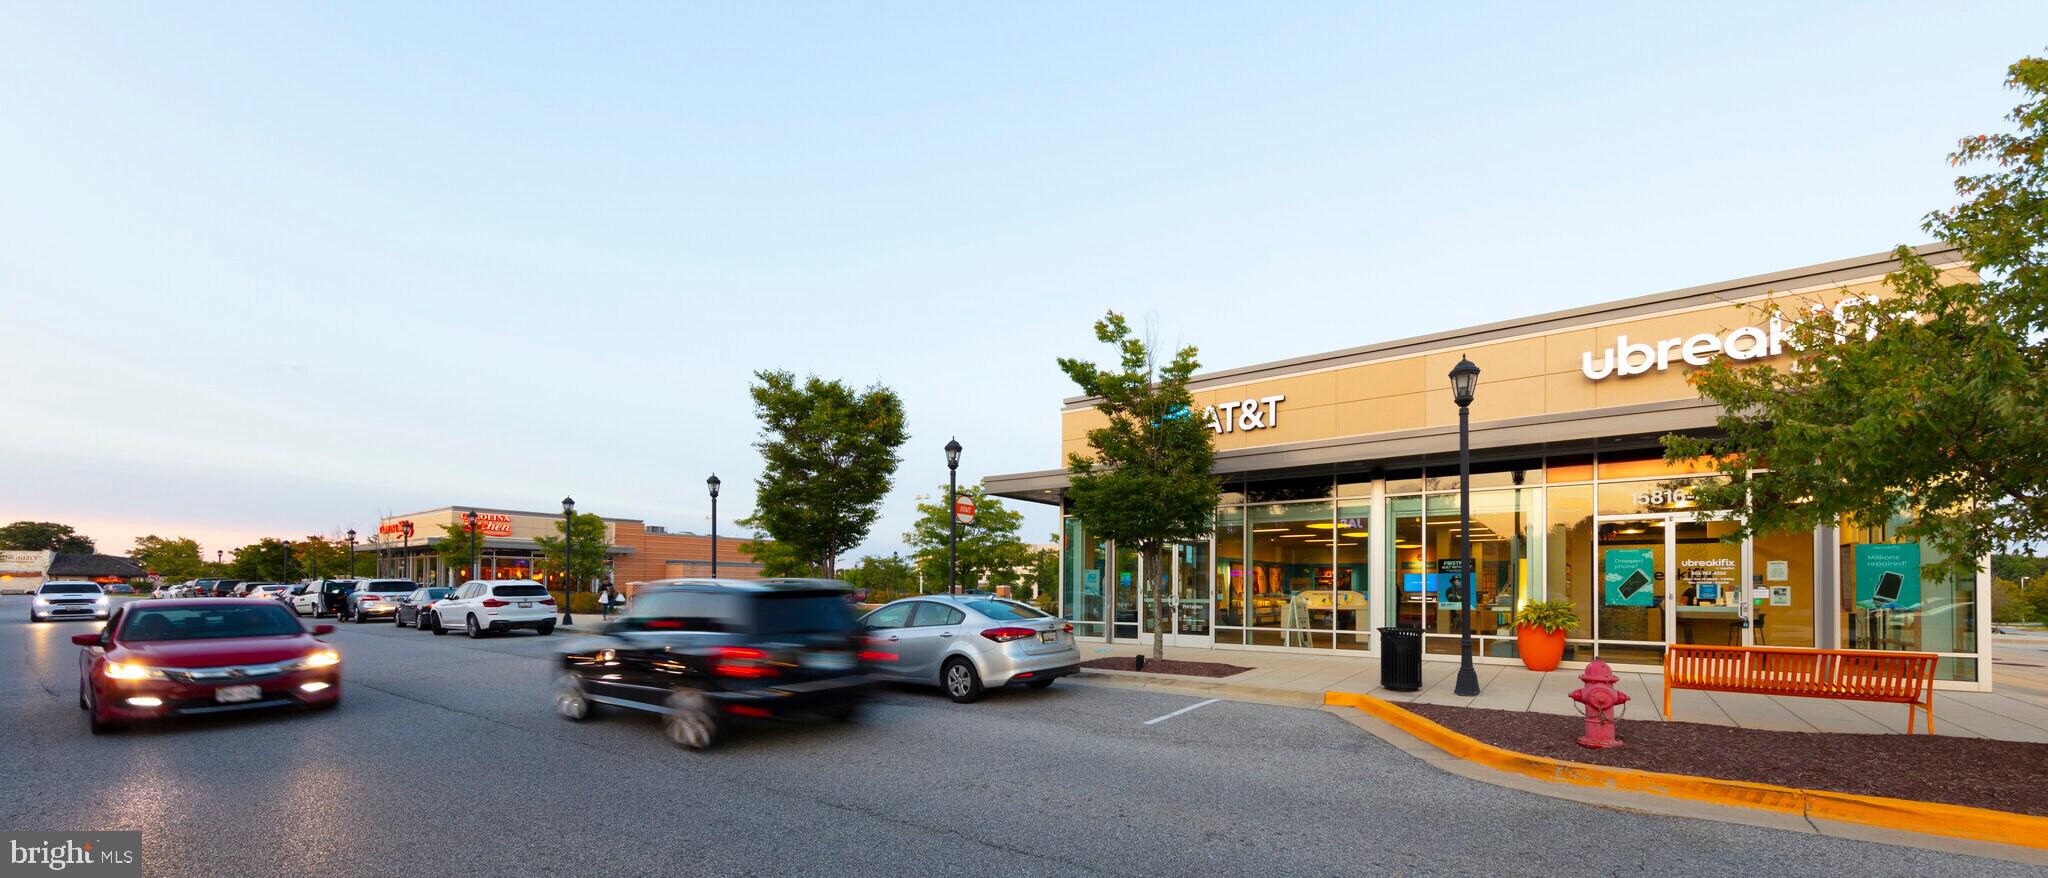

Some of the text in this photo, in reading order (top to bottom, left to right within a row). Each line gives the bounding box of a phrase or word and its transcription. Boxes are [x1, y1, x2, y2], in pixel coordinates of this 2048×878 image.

[1202, 395, 1285, 433] AT&T
[1632, 488, 1701, 505] 15816-
[1681, 559, 1736, 567] ubreakifix
